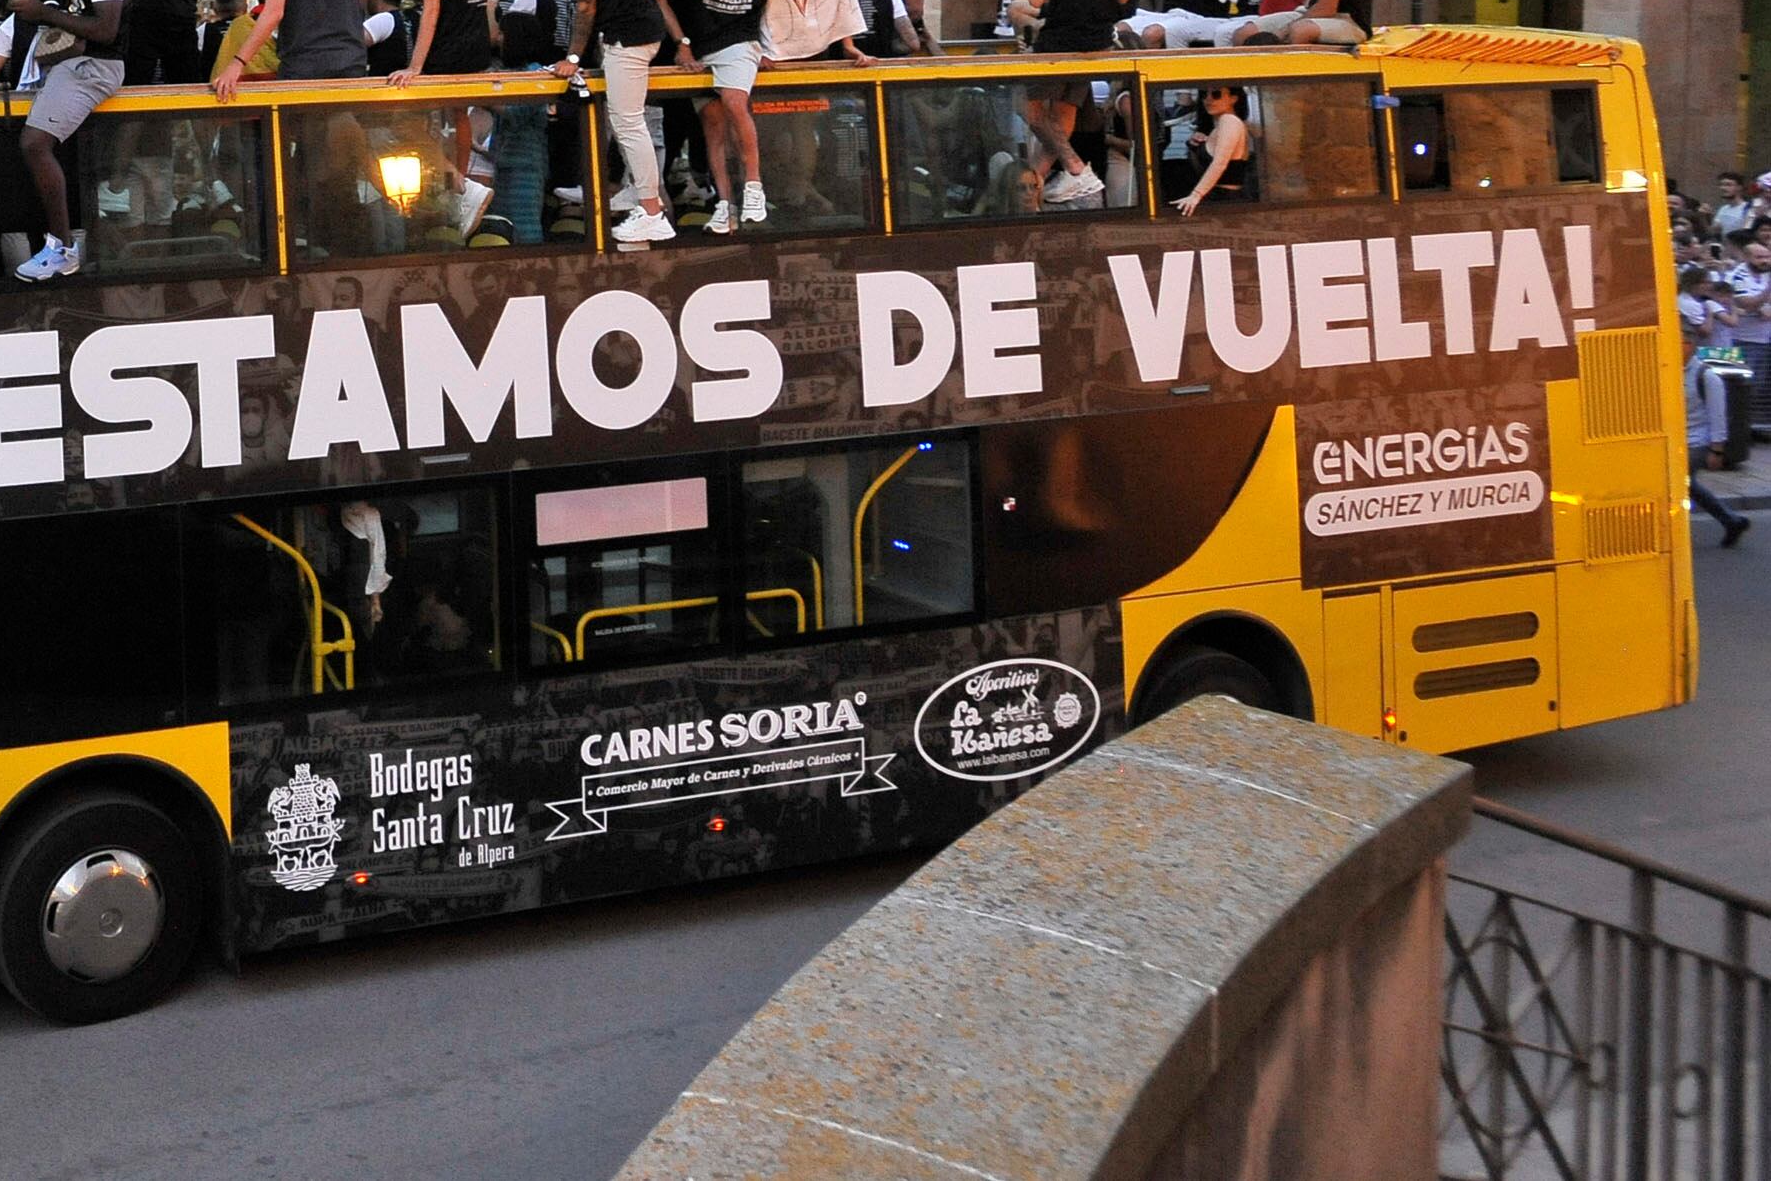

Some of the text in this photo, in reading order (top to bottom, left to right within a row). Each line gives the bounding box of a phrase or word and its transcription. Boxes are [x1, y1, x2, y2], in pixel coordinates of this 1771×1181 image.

[855, 261, 1044, 407] DE
[1107, 225, 1596, 382] VUELTA!
[1317, 481, 1531, 525] SÁNCHEZ Y MURCIA
[579, 717, 714, 767] CARNES
[957, 746, 1050, 770] www.laibanesa.com
[370, 748, 473, 804] Bodegas
[595, 749, 853, 799] Comercio Mayor de Carnes y Derivados Cárnicos
[371, 794, 515, 854] Santa Cruz
[458, 842, 516, 870] de Alpera
